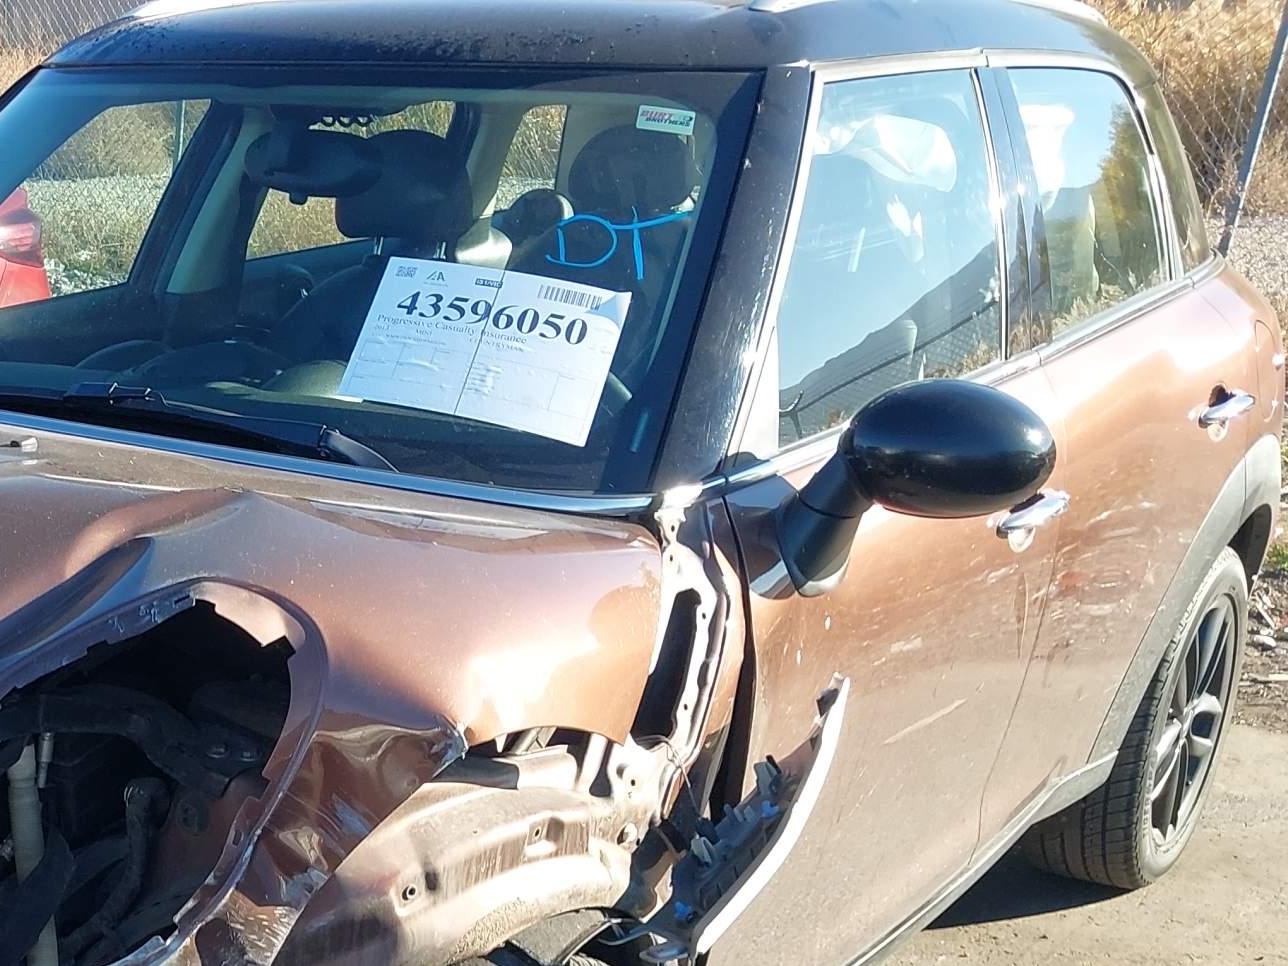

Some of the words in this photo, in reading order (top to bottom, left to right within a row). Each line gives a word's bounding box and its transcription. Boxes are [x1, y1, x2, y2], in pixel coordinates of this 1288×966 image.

[546, 207, 693, 280] DT
[377, 314, 433, 329] Progressive
[435, 321, 474, 336] Casualty
[396, 290, 588, 345] 43596050
